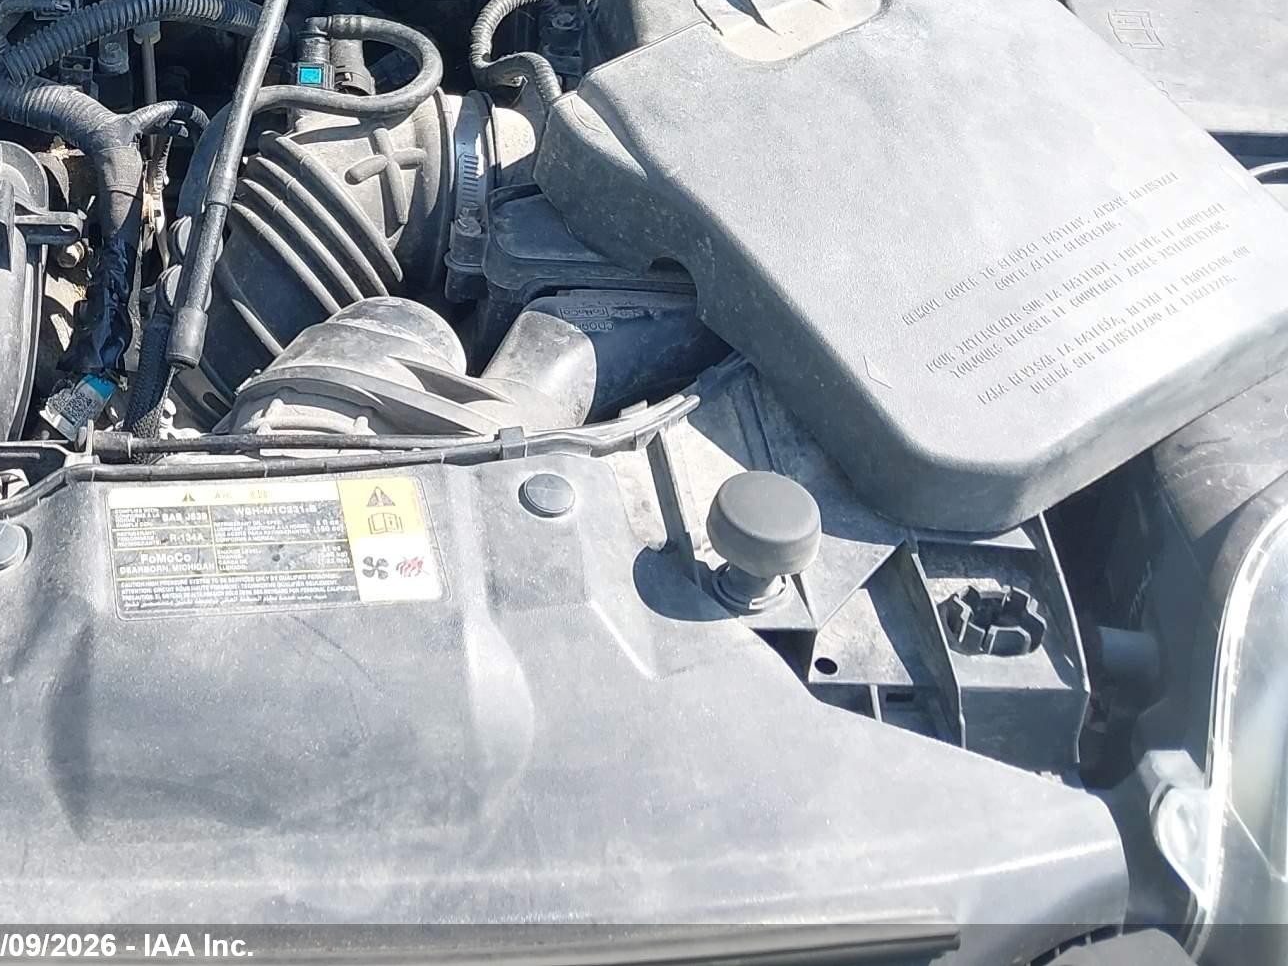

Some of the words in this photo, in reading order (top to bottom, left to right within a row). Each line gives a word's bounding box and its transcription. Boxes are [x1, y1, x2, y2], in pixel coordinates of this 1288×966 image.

[901, 299, 942, 325] REMOVE
[944, 278, 979, 300] COVER
[981, 267, 998, 280] TO
[997, 244, 1040, 270] SERVICE
[994, 269, 1029, 291] COVER
[1029, 250, 1063, 271] AFTER
[925, 352, 955, 372] POUR
[1022, 300, 1045, 315] SUR
[1045, 289, 1063, 302] LA
[949, 344, 1004, 379] TOUJOURS
[1004, 316, 1052, 346] REPOSER
[977, 383, 1008, 404] PARA
[1007, 354, 1056, 385] REVISAR
[1073, 353, 1096, 369] SER
[161, 513, 182, 521] SAE
[139, 552, 192, 563] FoMoCo
[171, 563, 215, 571] MICHIGAN
